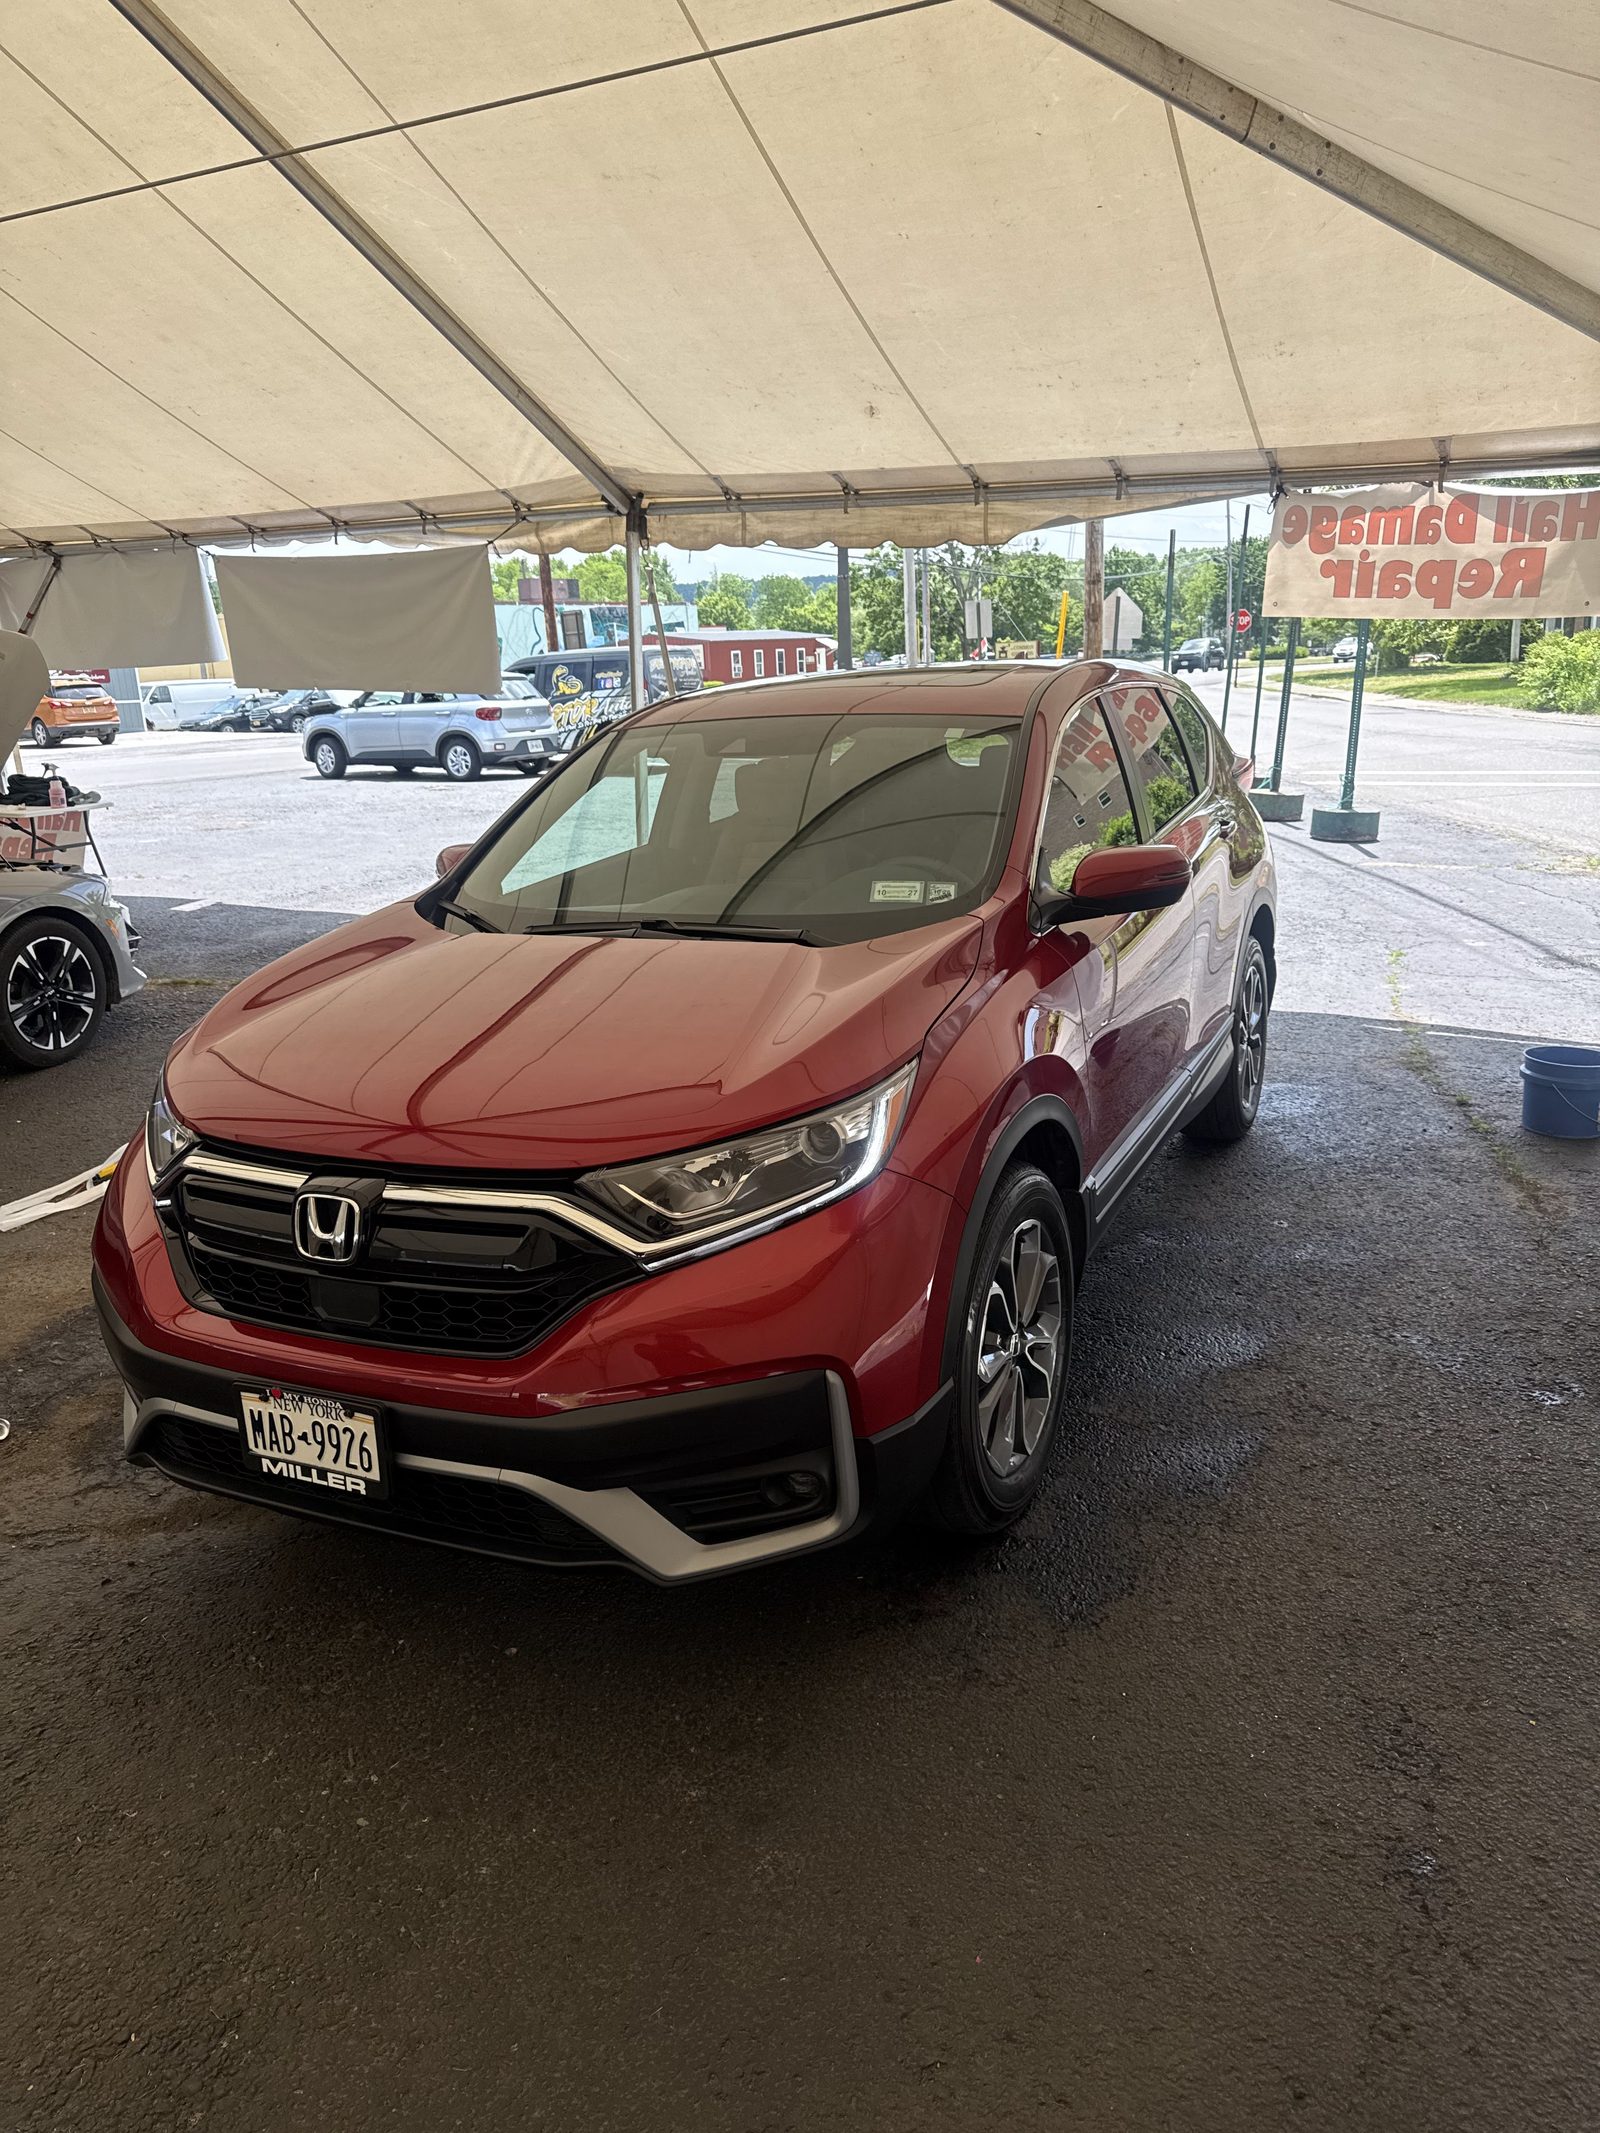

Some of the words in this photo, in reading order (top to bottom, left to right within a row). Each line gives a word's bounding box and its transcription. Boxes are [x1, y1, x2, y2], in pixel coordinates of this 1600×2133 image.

[266, 1389, 271, 1397] I
[283, 1392, 301, 1401] MY
[303, 1396, 343, 1409] HONDA
[273, 1398, 304, 1414] NEW
[305, 1403, 346, 1423] YORK
[261, 1457, 367, 1495] MILLER
